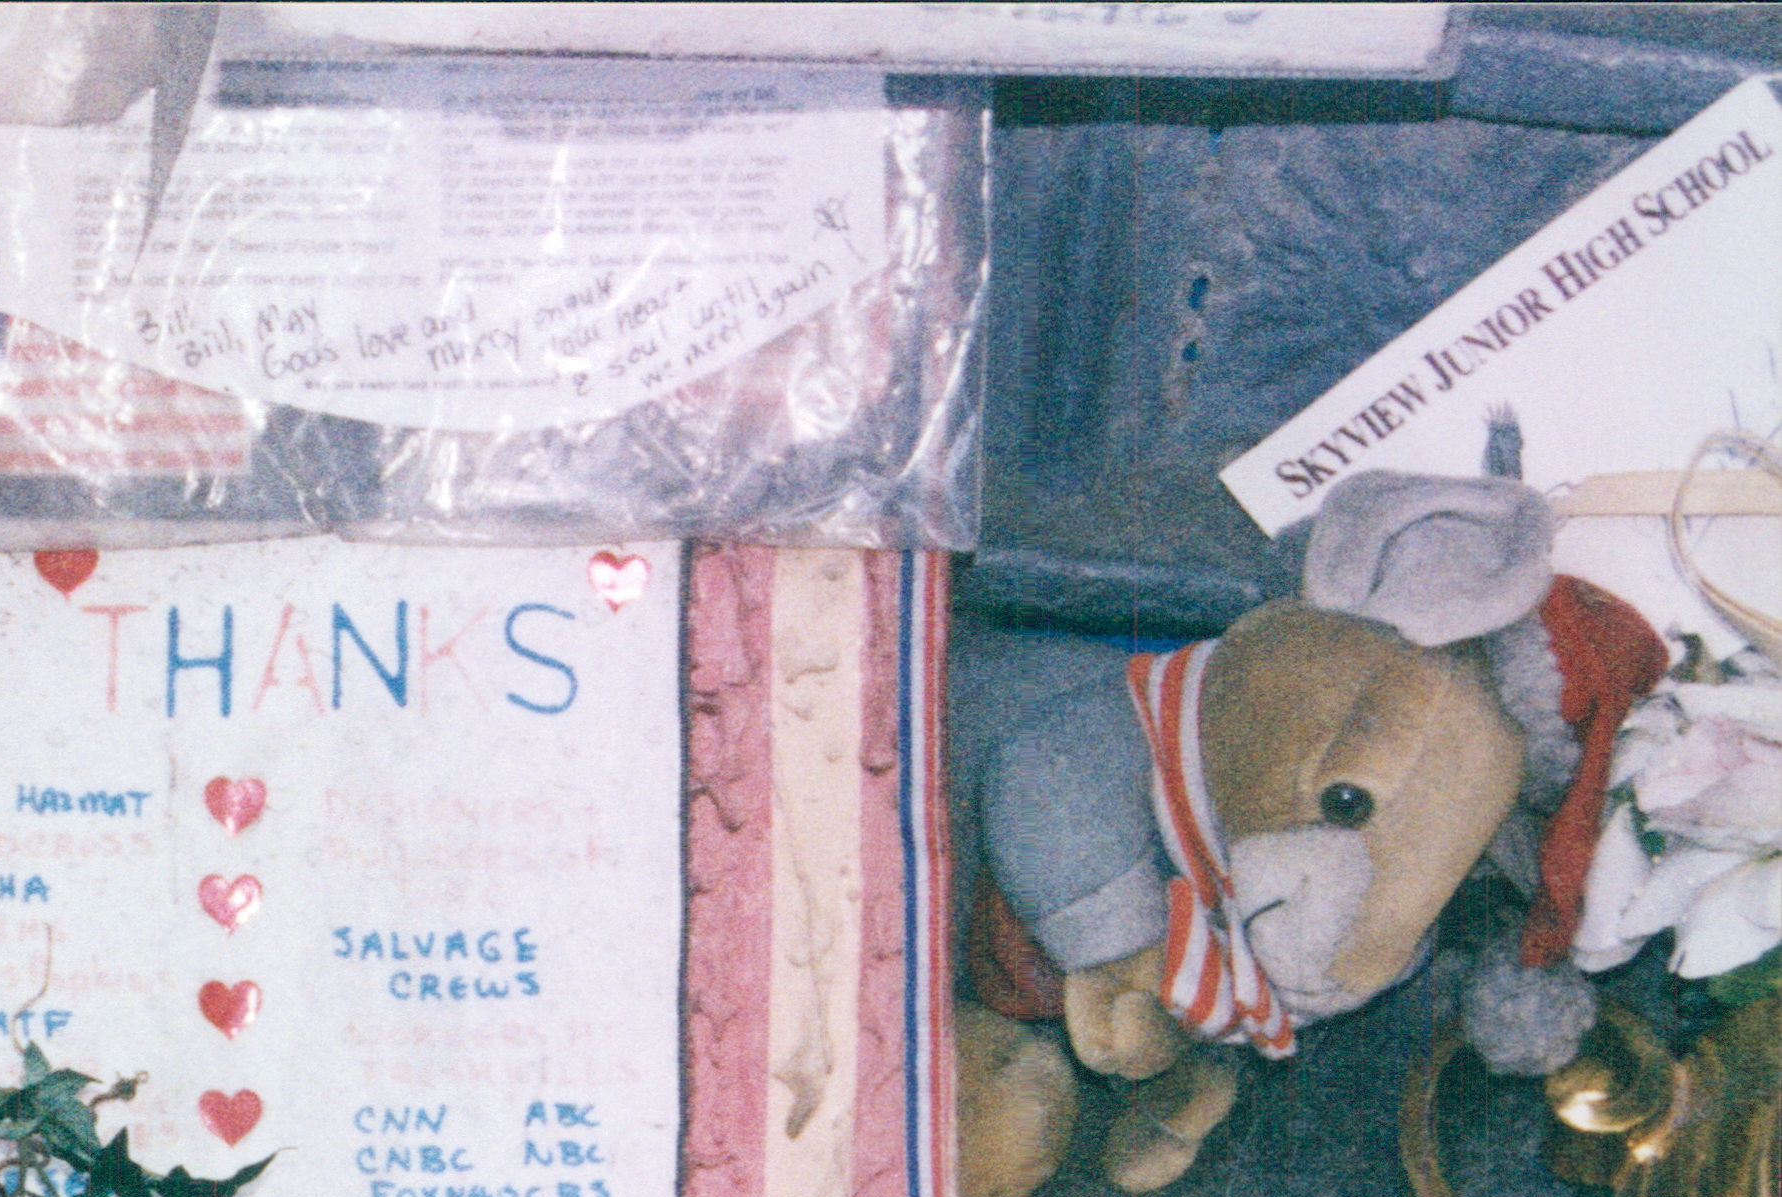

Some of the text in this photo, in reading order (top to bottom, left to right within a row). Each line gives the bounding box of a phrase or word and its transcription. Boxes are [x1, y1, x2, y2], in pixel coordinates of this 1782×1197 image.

[755, 258, 834, 319] again
[356, 320, 412, 361] love
[421, 297, 477, 338] and
[1274, 128, 1775, 502] SKYVIEW JUNIOR HIGH SCHOOL
[80, 598, 579, 718] THANKS
[330, 925, 540, 970] SALVAGE
[386, 969, 542, 1002] CREWS
[352, 1103, 449, 1136] CNN
[523, 1100, 602, 1128] ABC
[354, 1143, 475, 1175] CNBC
[522, 1138, 607, 1168] NBC
